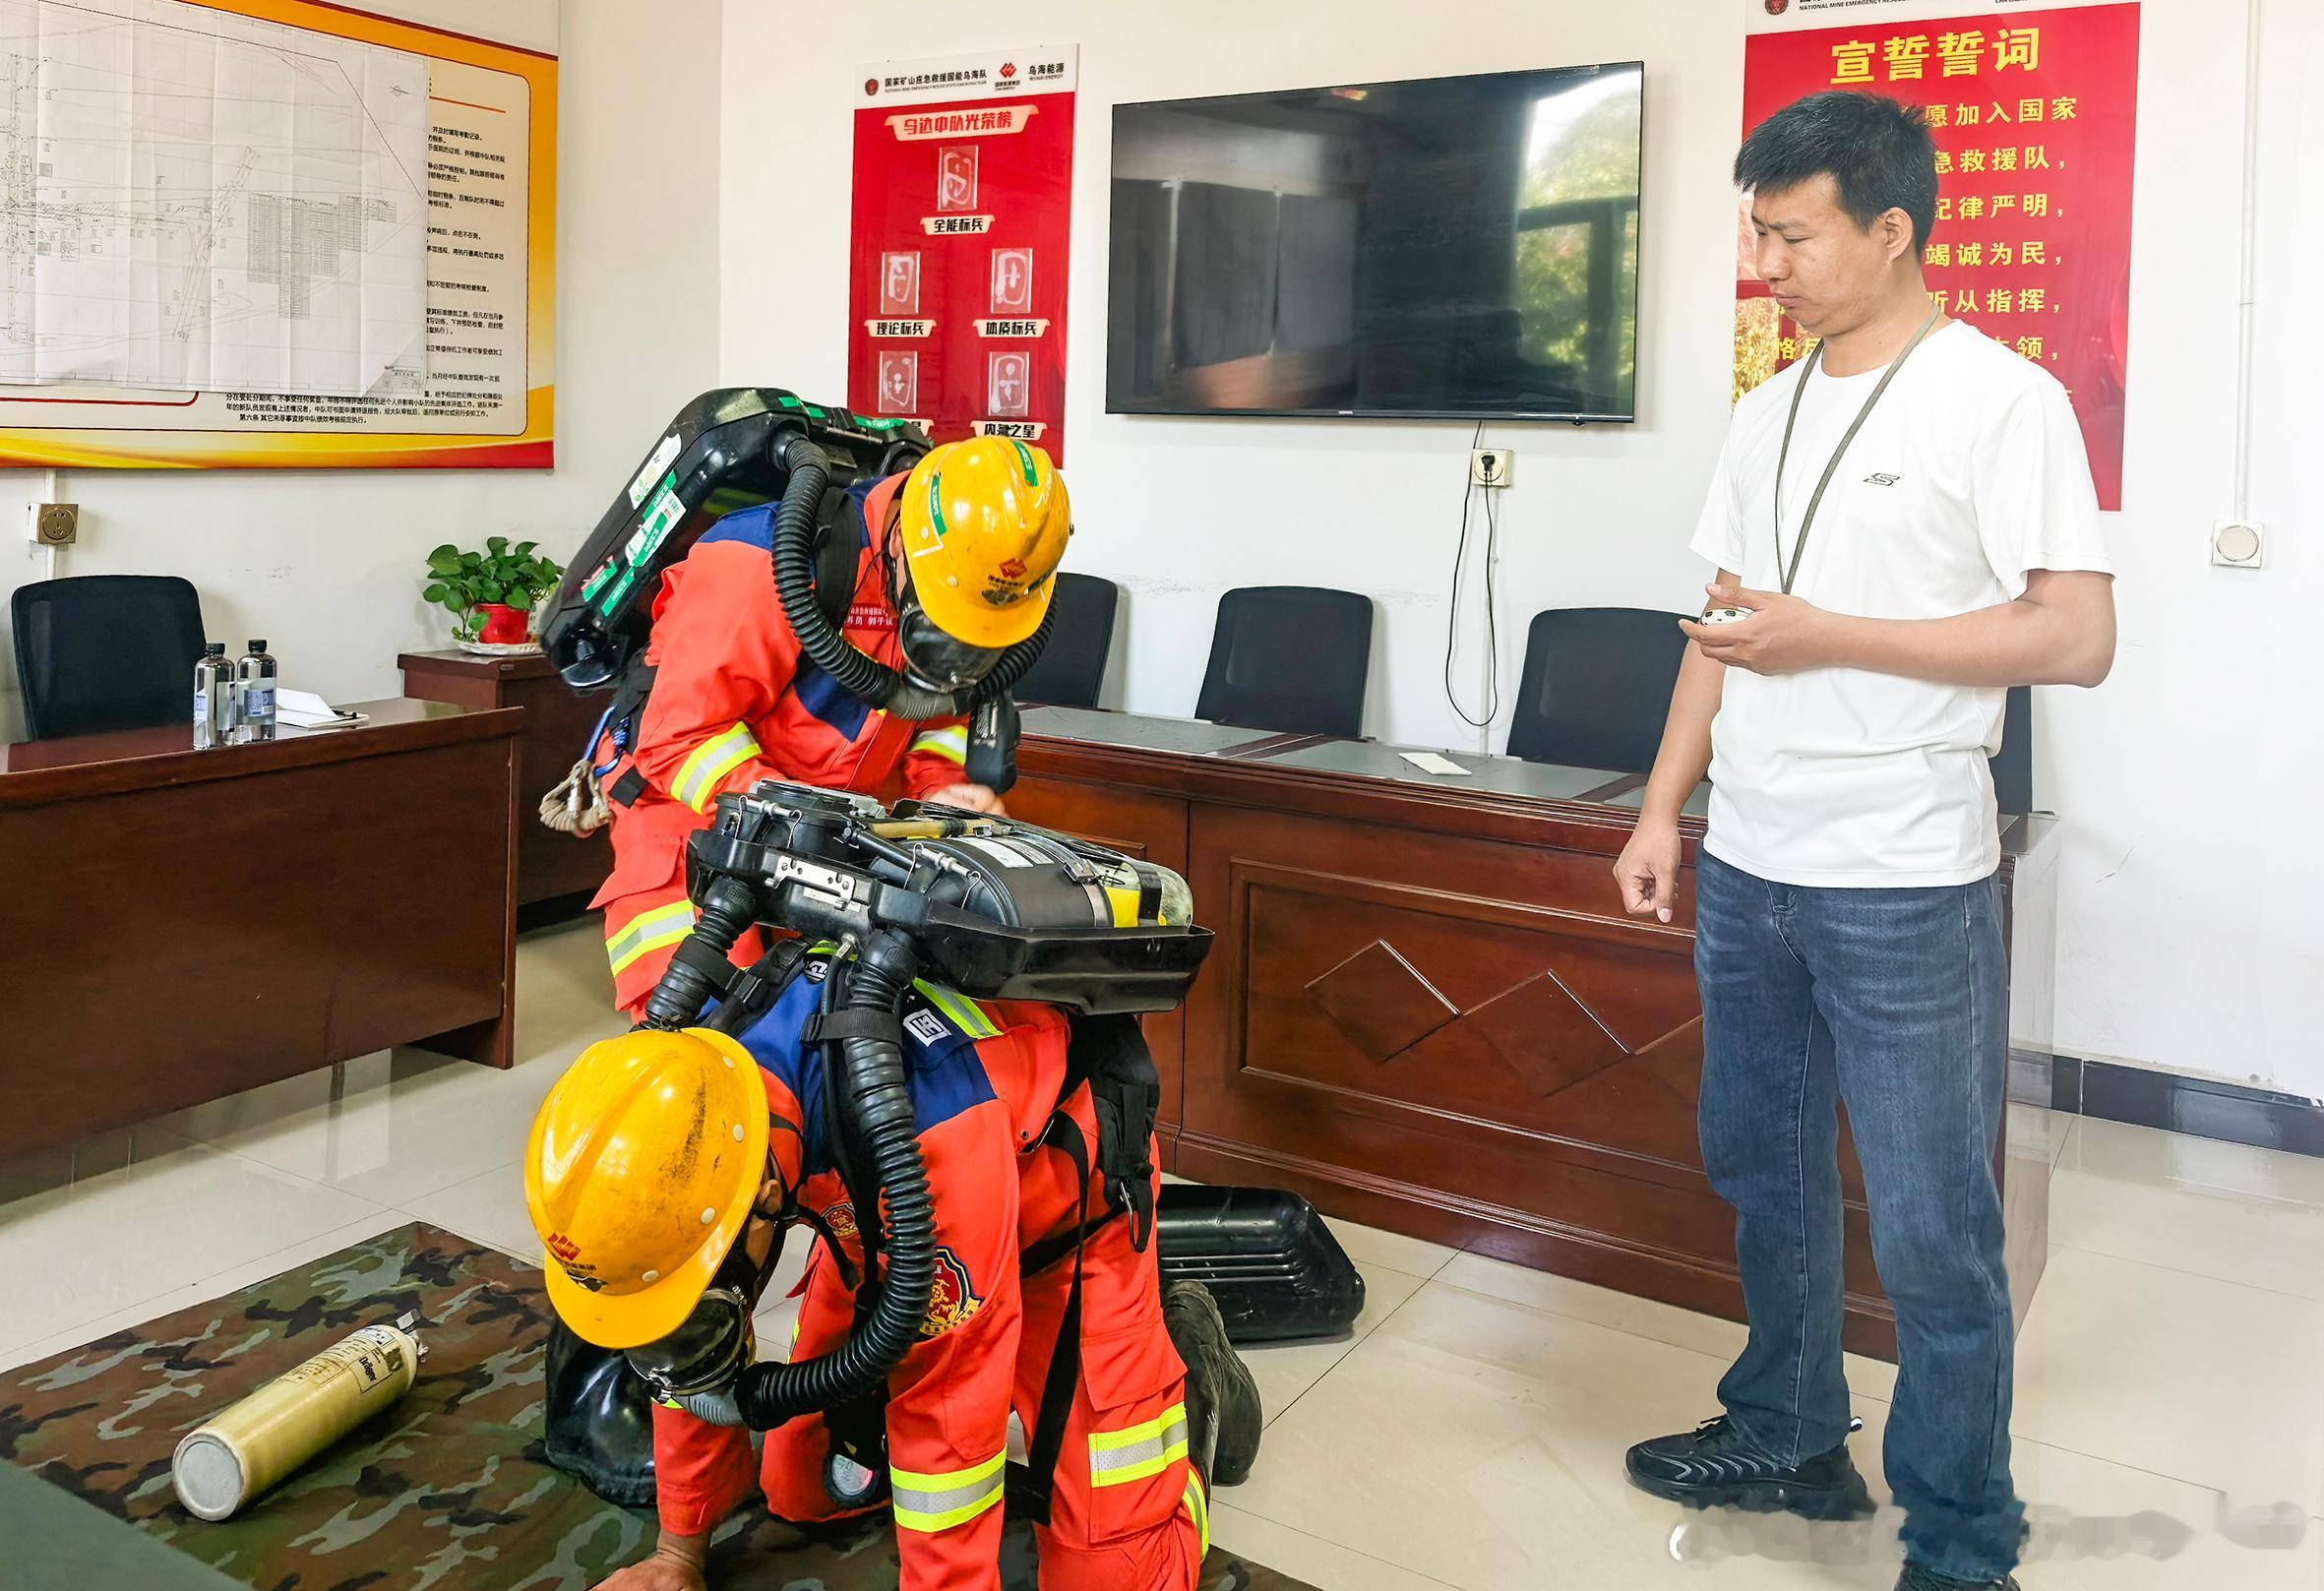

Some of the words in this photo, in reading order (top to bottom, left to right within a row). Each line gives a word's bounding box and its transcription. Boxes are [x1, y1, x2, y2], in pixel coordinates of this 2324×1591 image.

[1830, 28, 2041, 85] 宣誓誓词
[885, 69, 987, 87] 国家矿山应急救援国能乌海队
[1028, 62, 1065, 76] 乌海能源
[903, 111, 1012, 135] 乌达中队光荣榜
[934, 217, 984, 233] 全能标兵
[1925, 241, 2062, 267] 竭诚为民，
[877, 322, 925, 337] 理论标兵
[986, 322, 1037, 337] 体质标兵
[1995, 336, 2058, 361] 领，
[358, 1356, 377, 1381] Dräger
